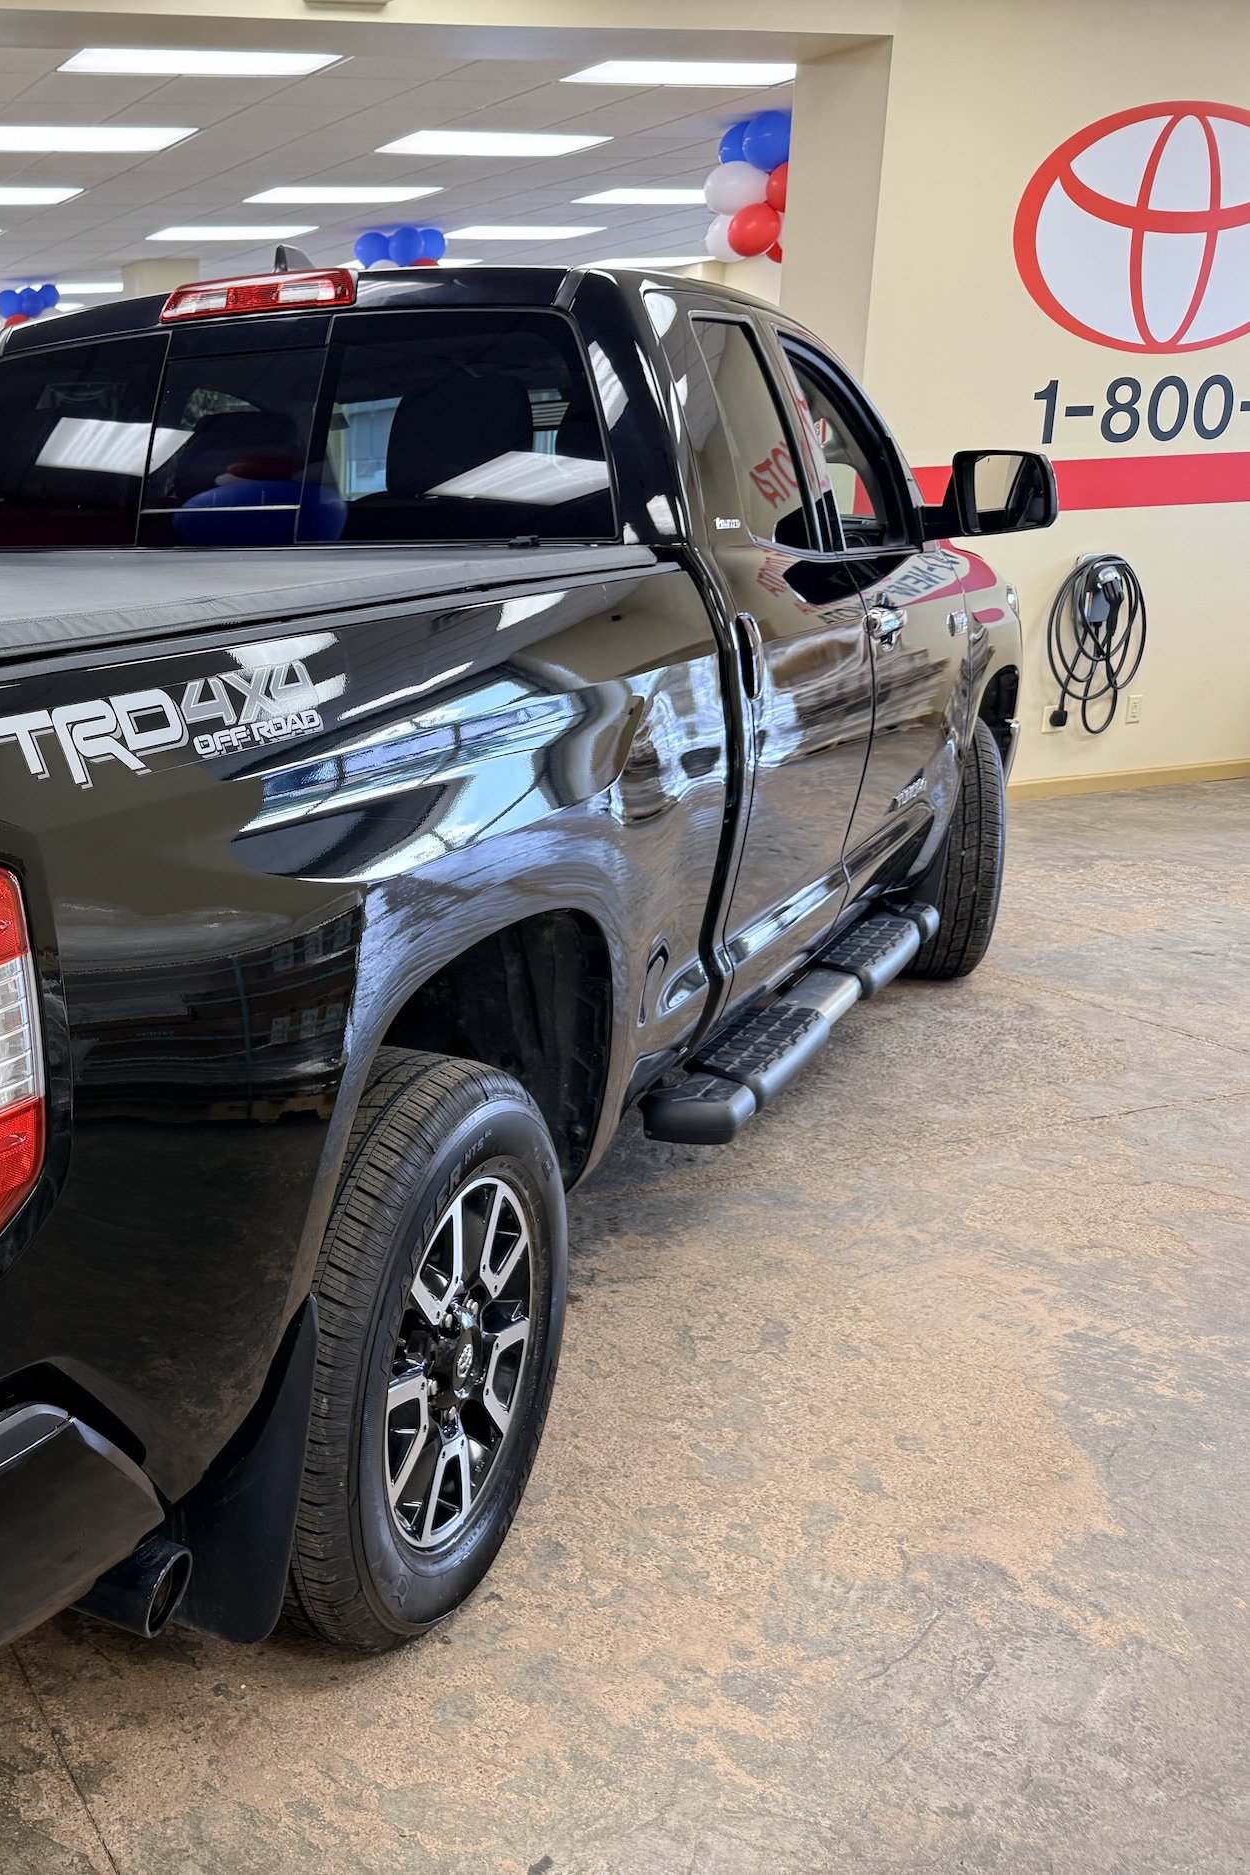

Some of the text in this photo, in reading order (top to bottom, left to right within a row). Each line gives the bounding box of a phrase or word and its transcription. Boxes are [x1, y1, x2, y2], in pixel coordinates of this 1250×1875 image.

[180, 660, 320, 726] 4X4
[193, 709, 324, 760] OFF ROAD
